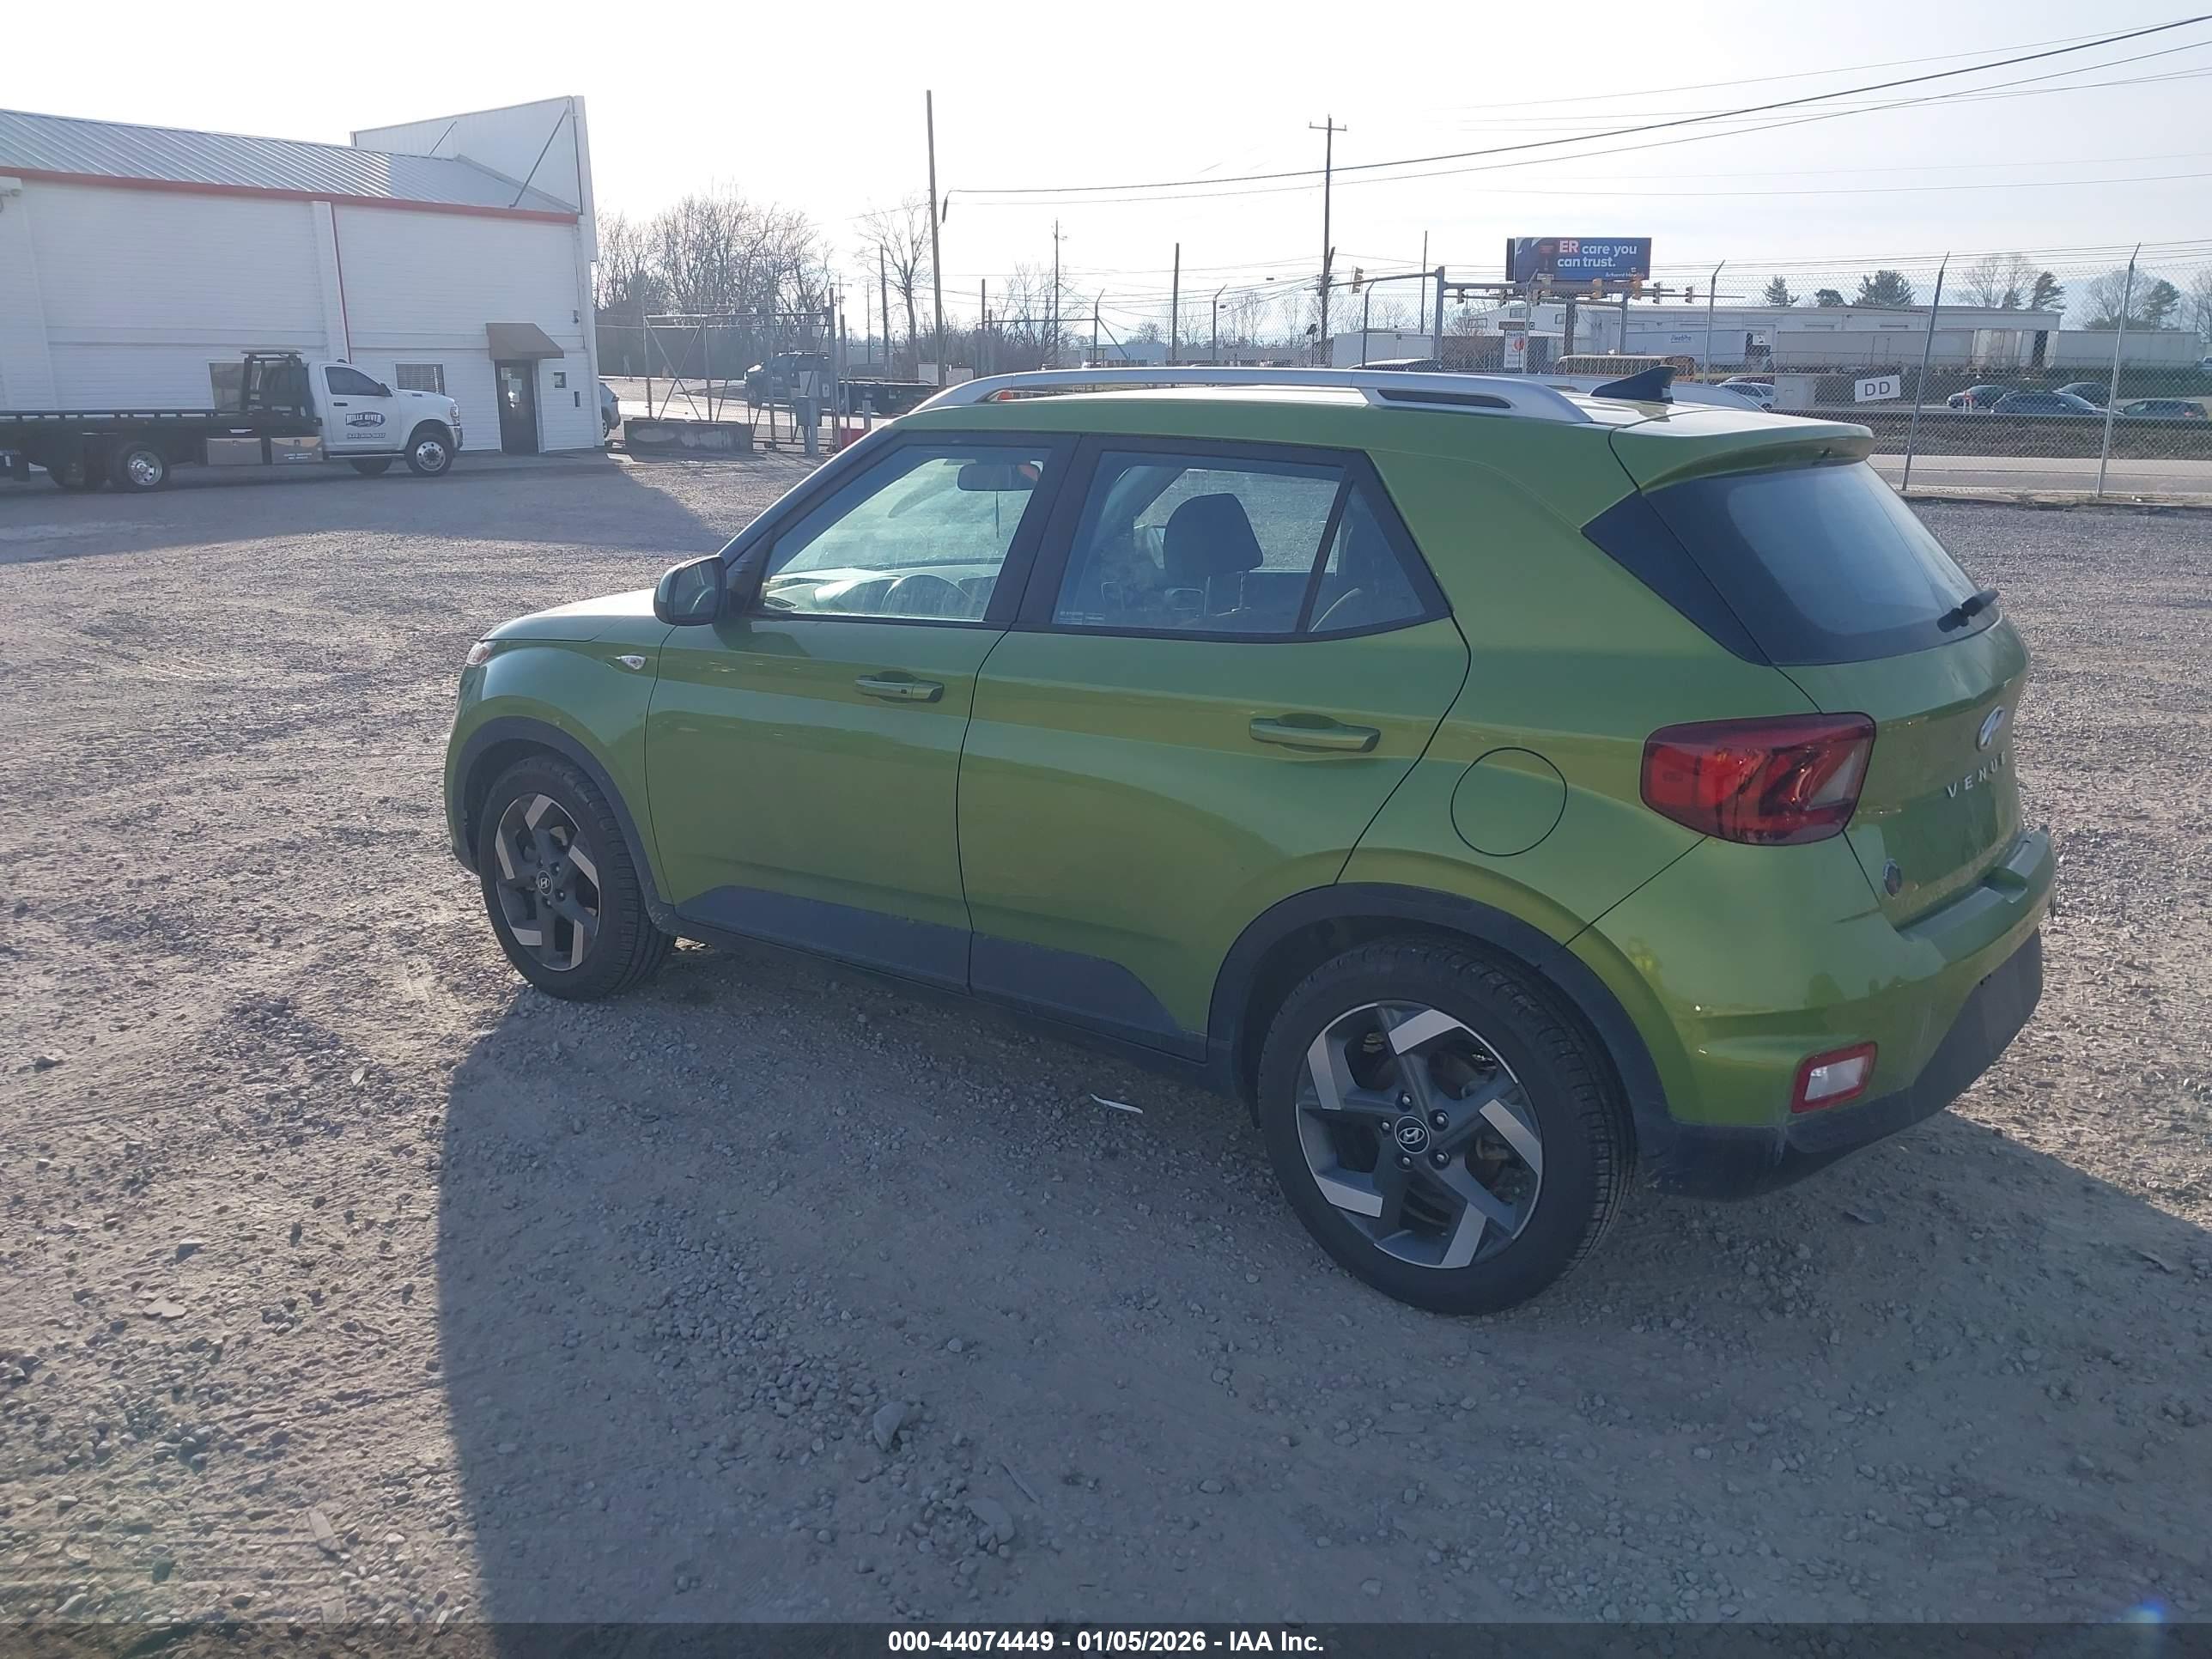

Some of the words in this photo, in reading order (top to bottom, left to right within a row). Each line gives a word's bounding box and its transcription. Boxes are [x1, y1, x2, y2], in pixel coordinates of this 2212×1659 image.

[1559, 240, 1579, 253] ER
[1582, 245, 1610, 254] care
[1613, 246, 1638, 257] you
[1557, 258, 1580, 267] can
[1583, 256, 1616, 267] trust.
[1946, 750, 2007, 799] VENUE
